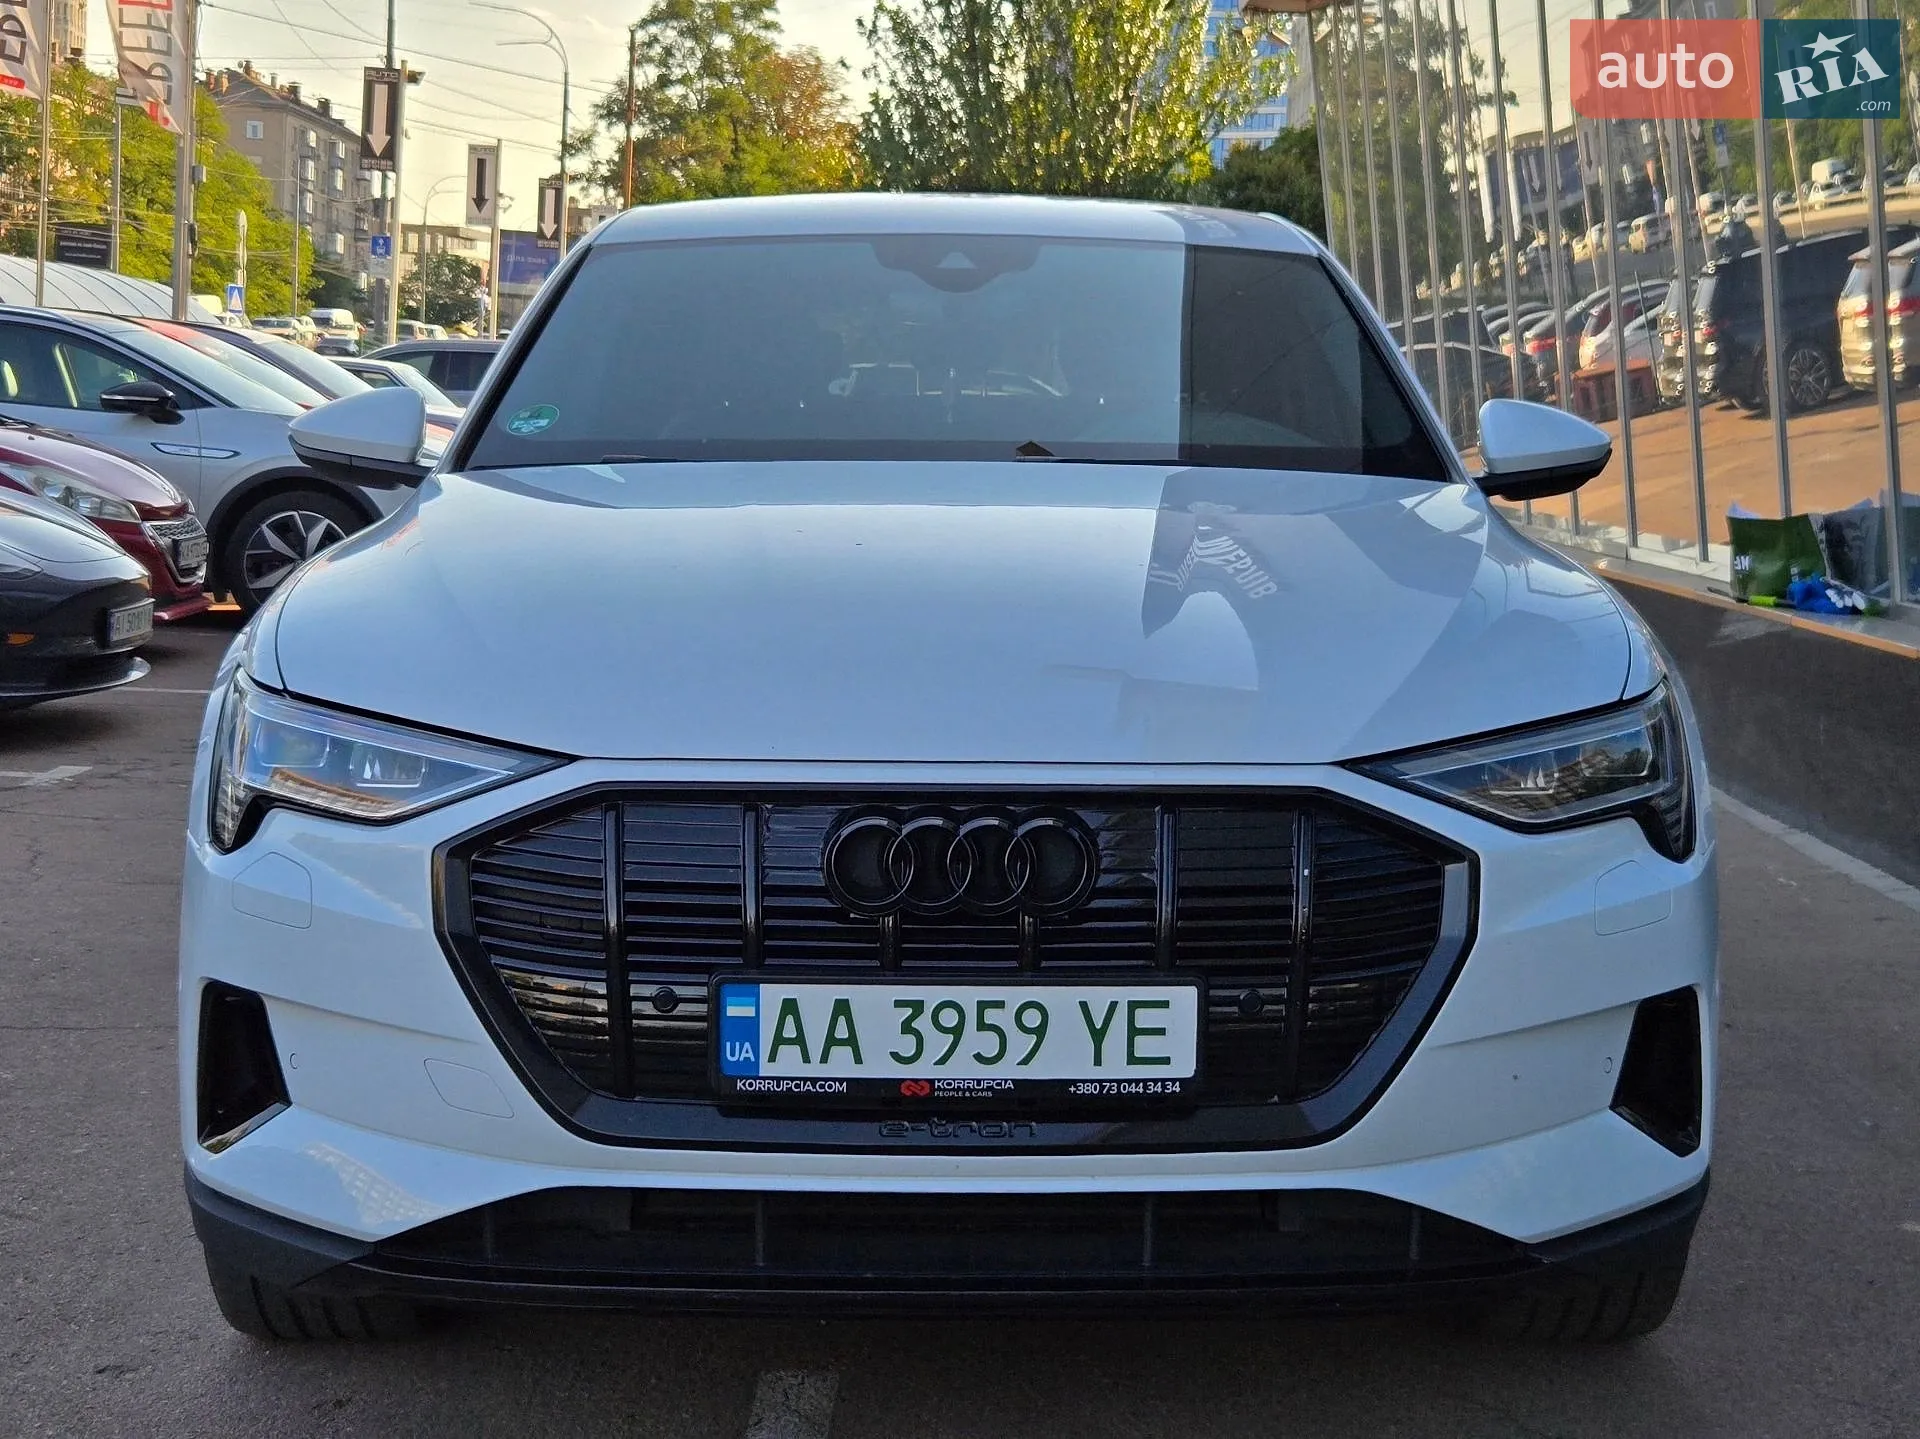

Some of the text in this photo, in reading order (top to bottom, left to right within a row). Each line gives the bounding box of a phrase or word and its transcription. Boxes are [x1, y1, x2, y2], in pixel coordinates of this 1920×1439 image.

[767, 998, 1171, 1067] AA 3959 YE
[725, 1041, 755, 1062] UA
[736, 1079, 847, 1093] KORRUPCIA.COM
[934, 1079, 1015, 1090] KORRUPCIA
[1068, 1081, 1181, 1094] +380 73 044 34 34
[879, 1117, 1037, 1138] e-tron
